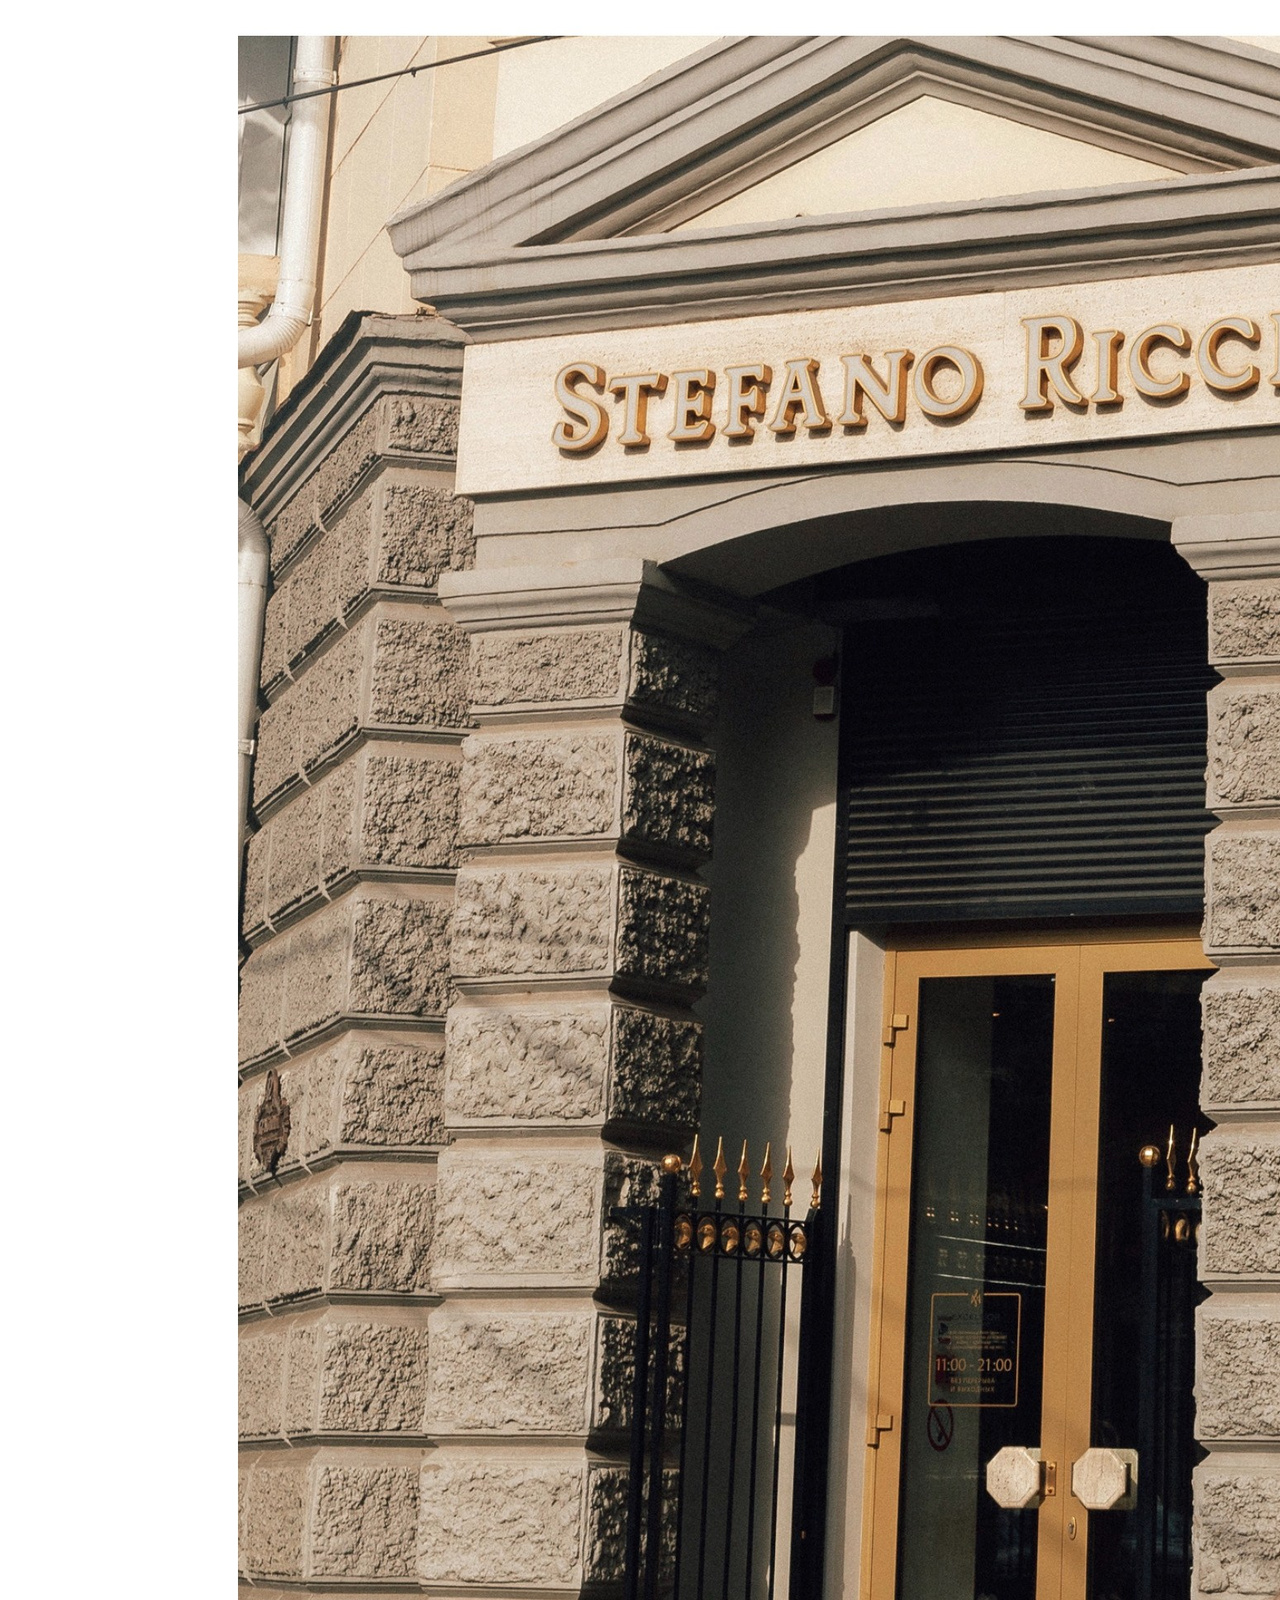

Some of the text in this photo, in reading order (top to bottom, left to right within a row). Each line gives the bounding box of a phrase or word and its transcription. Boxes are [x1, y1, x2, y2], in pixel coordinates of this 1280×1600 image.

[550, 344, 985, 452] STEFANO
[935, 1358, 967, 1372] 11:00
[977, 1358, 1013, 1372] 21:00
